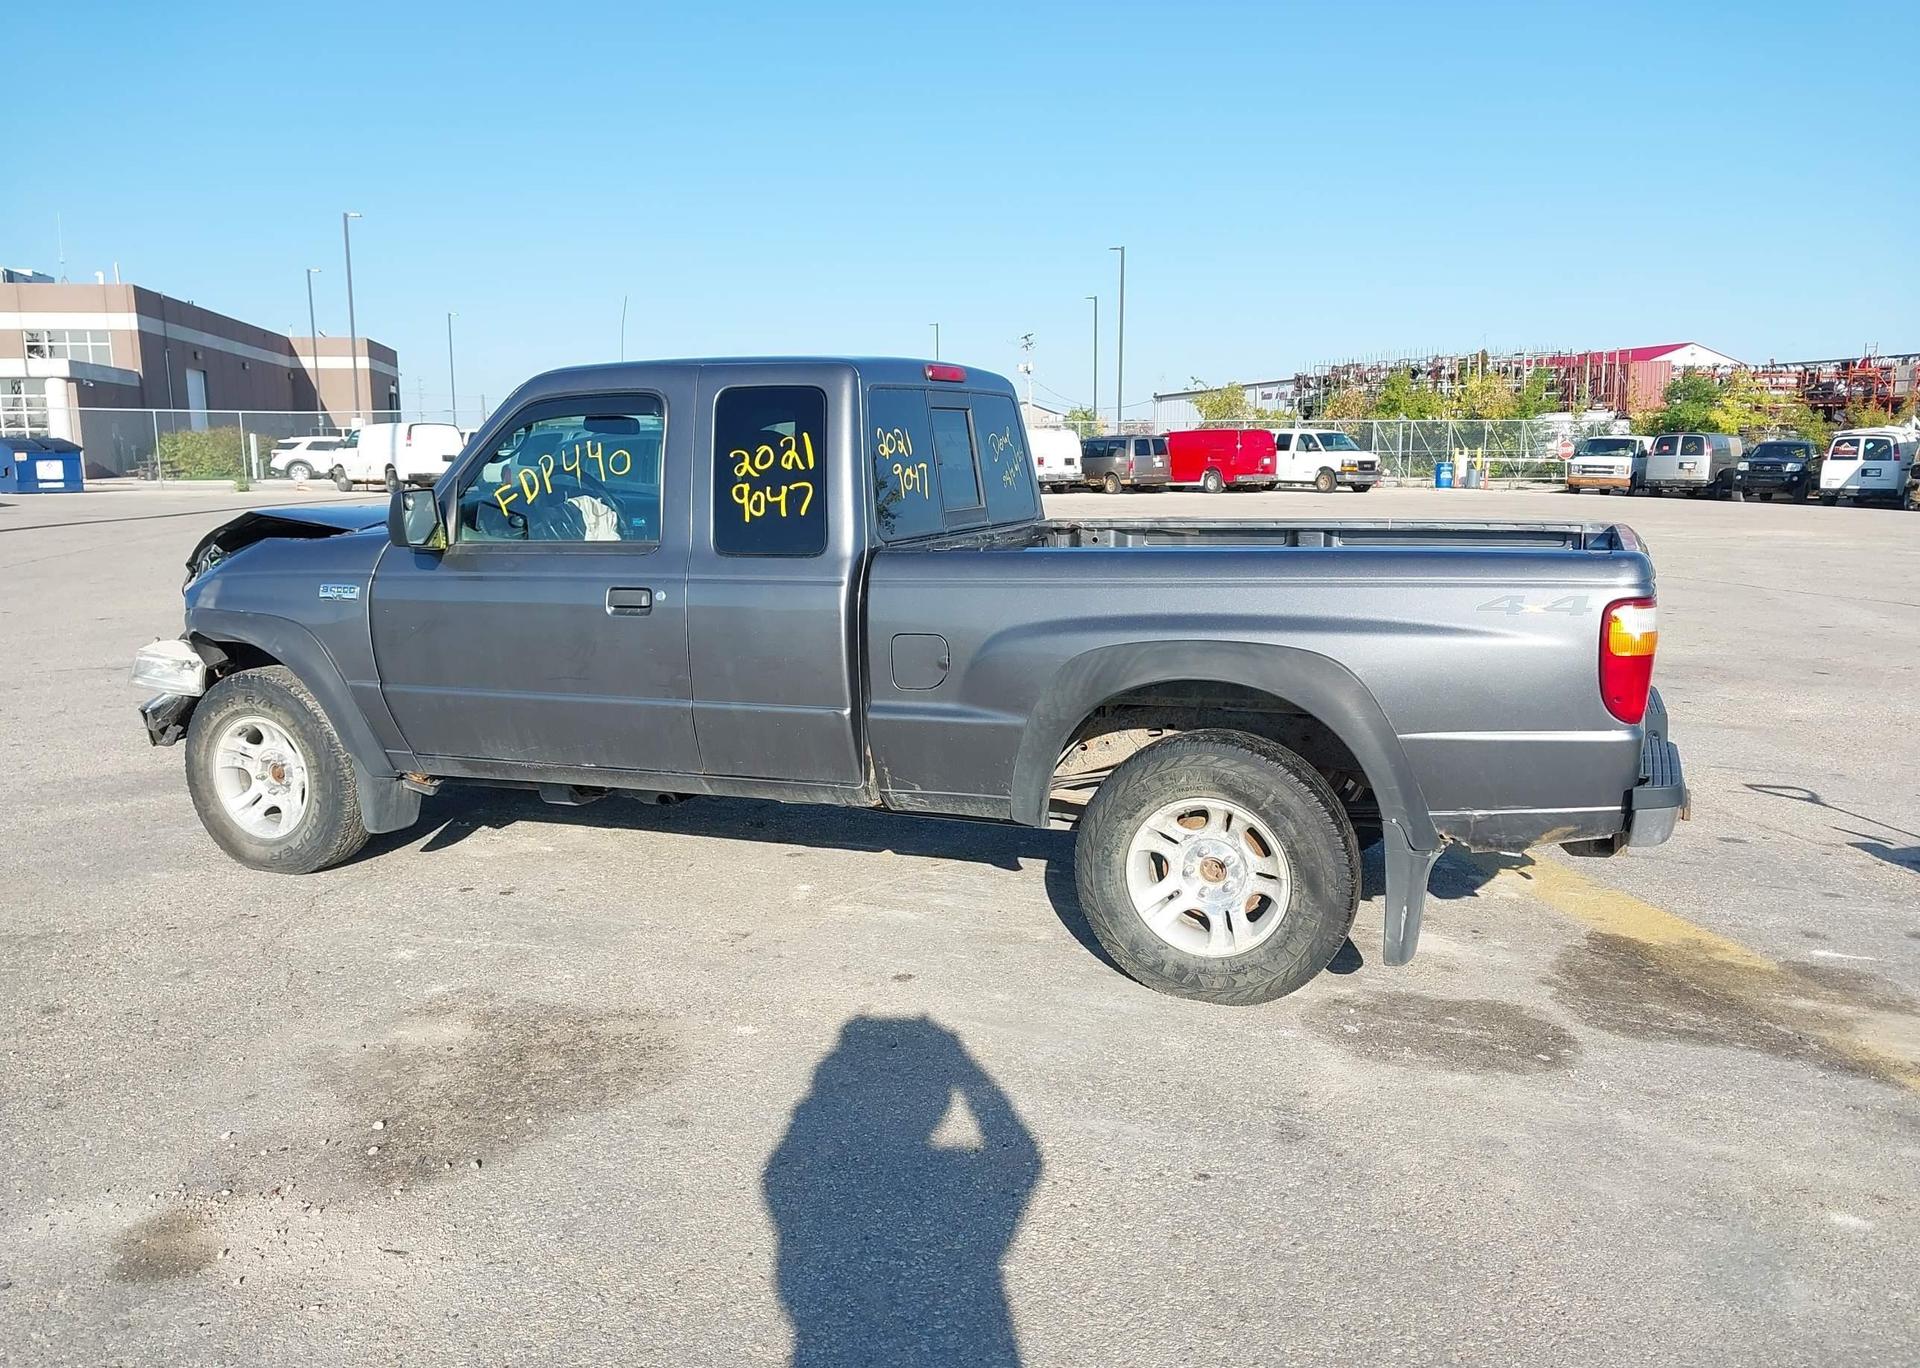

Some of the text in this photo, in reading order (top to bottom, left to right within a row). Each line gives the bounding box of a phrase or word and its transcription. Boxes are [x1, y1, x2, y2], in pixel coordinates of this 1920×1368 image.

[729, 432, 815, 477] 2021
[876, 427, 913, 460] 2021
[493, 440, 632, 517] FDP440
[893, 462, 930, 500] 9047
[731, 482, 814, 522] 9047
